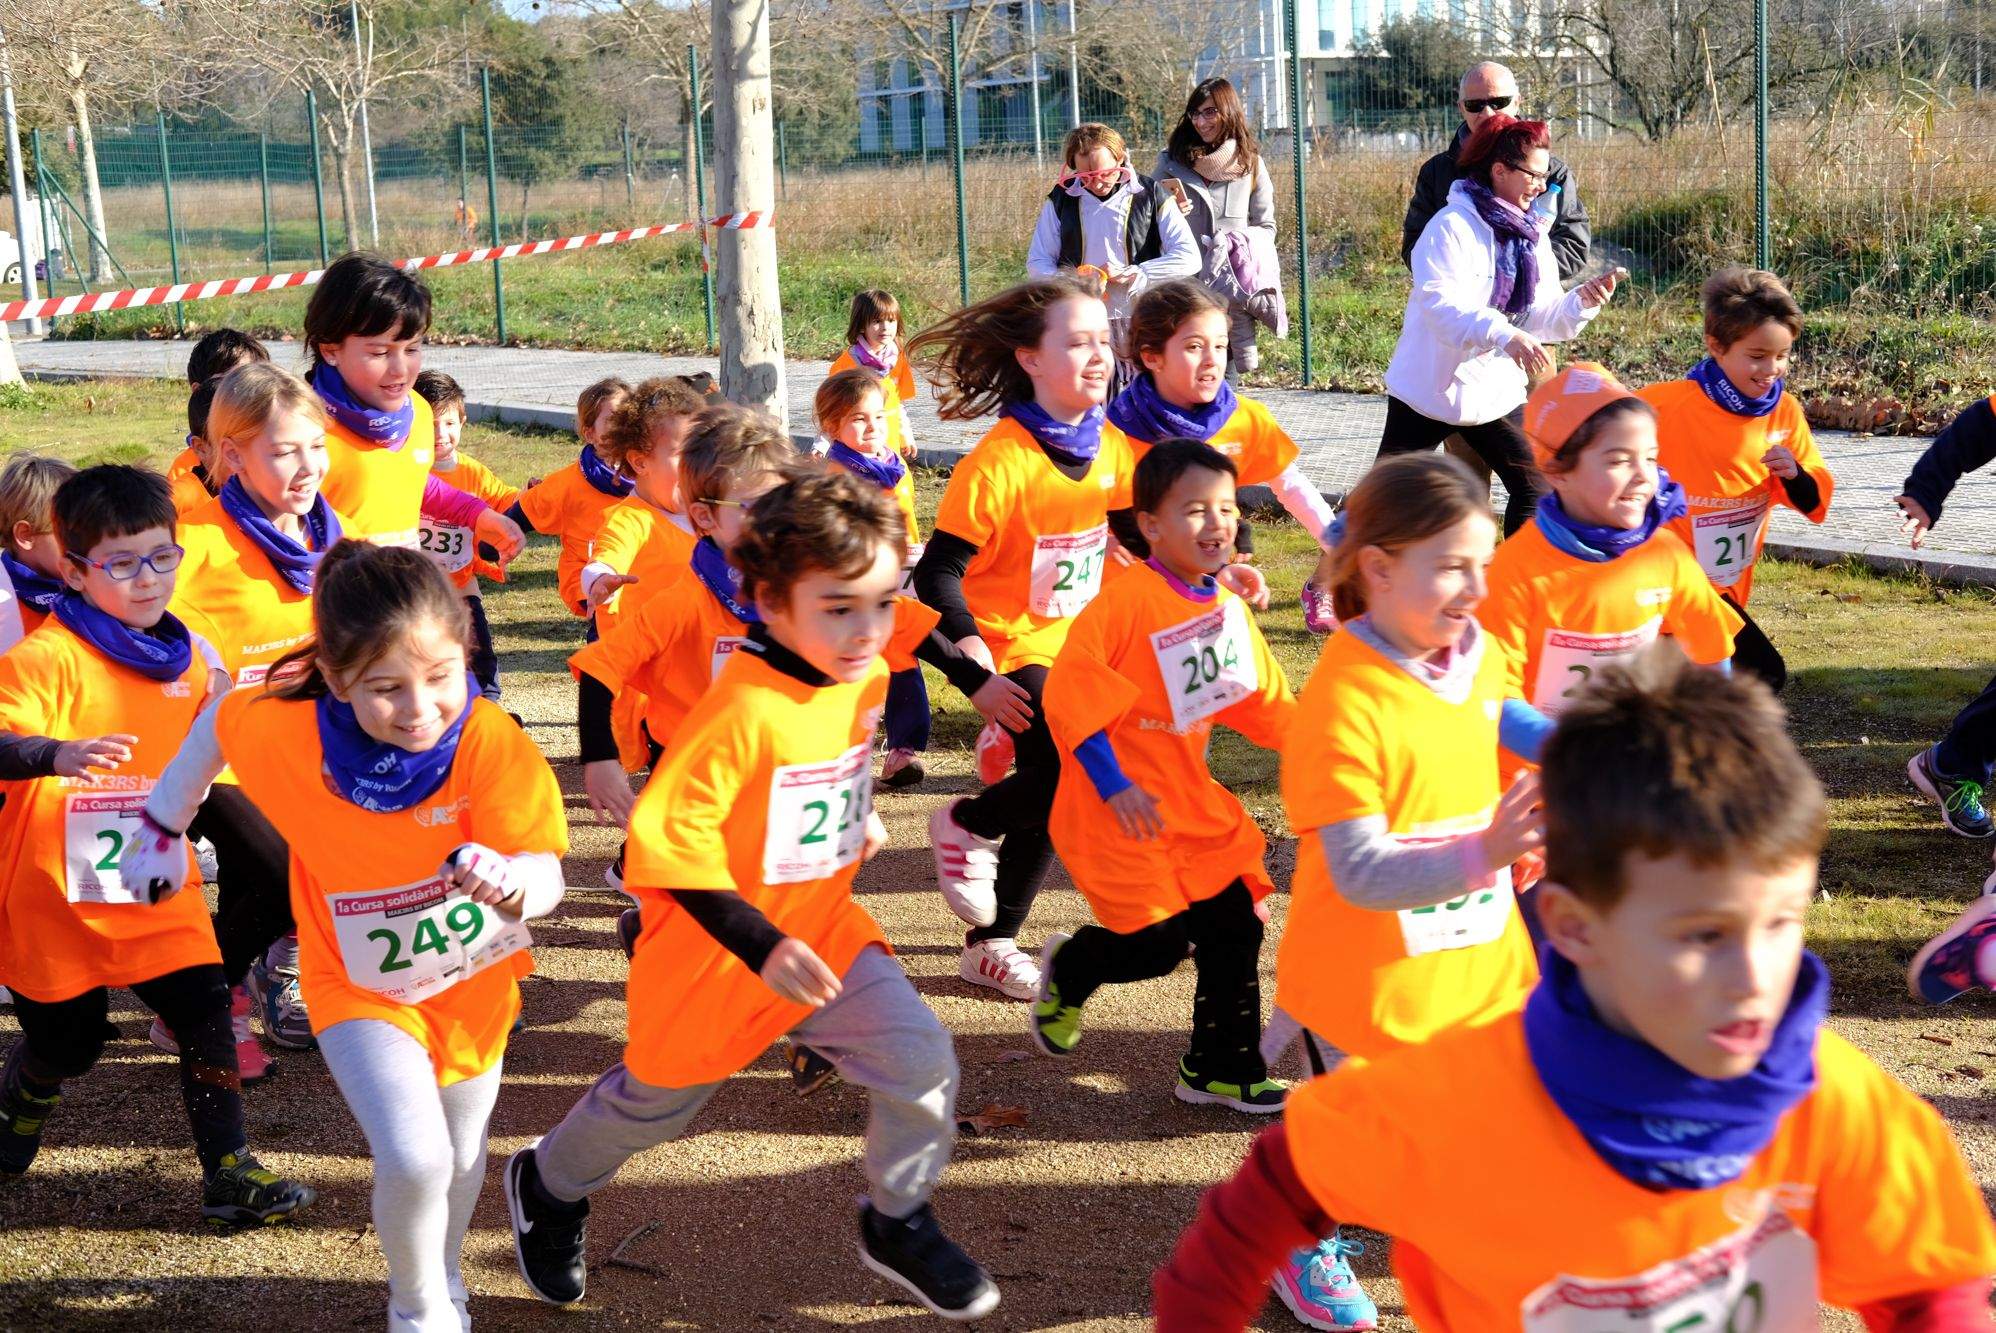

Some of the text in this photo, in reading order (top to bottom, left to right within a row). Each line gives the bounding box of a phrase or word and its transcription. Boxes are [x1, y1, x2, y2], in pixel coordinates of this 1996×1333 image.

[1718, 378, 1745, 410] RICOH
[419, 528, 463, 555] 233
[1052, 548, 1105, 591] 247
[1182, 638, 1238, 694] 204
[75, 800, 88, 811] 1a
[89, 800, 122, 811] Cursa
[336, 900, 350, 914] 1a
[350, 897, 385, 912] Cursa
[386, 884, 443, 907] solidària
[366, 902, 484, 974] 249
